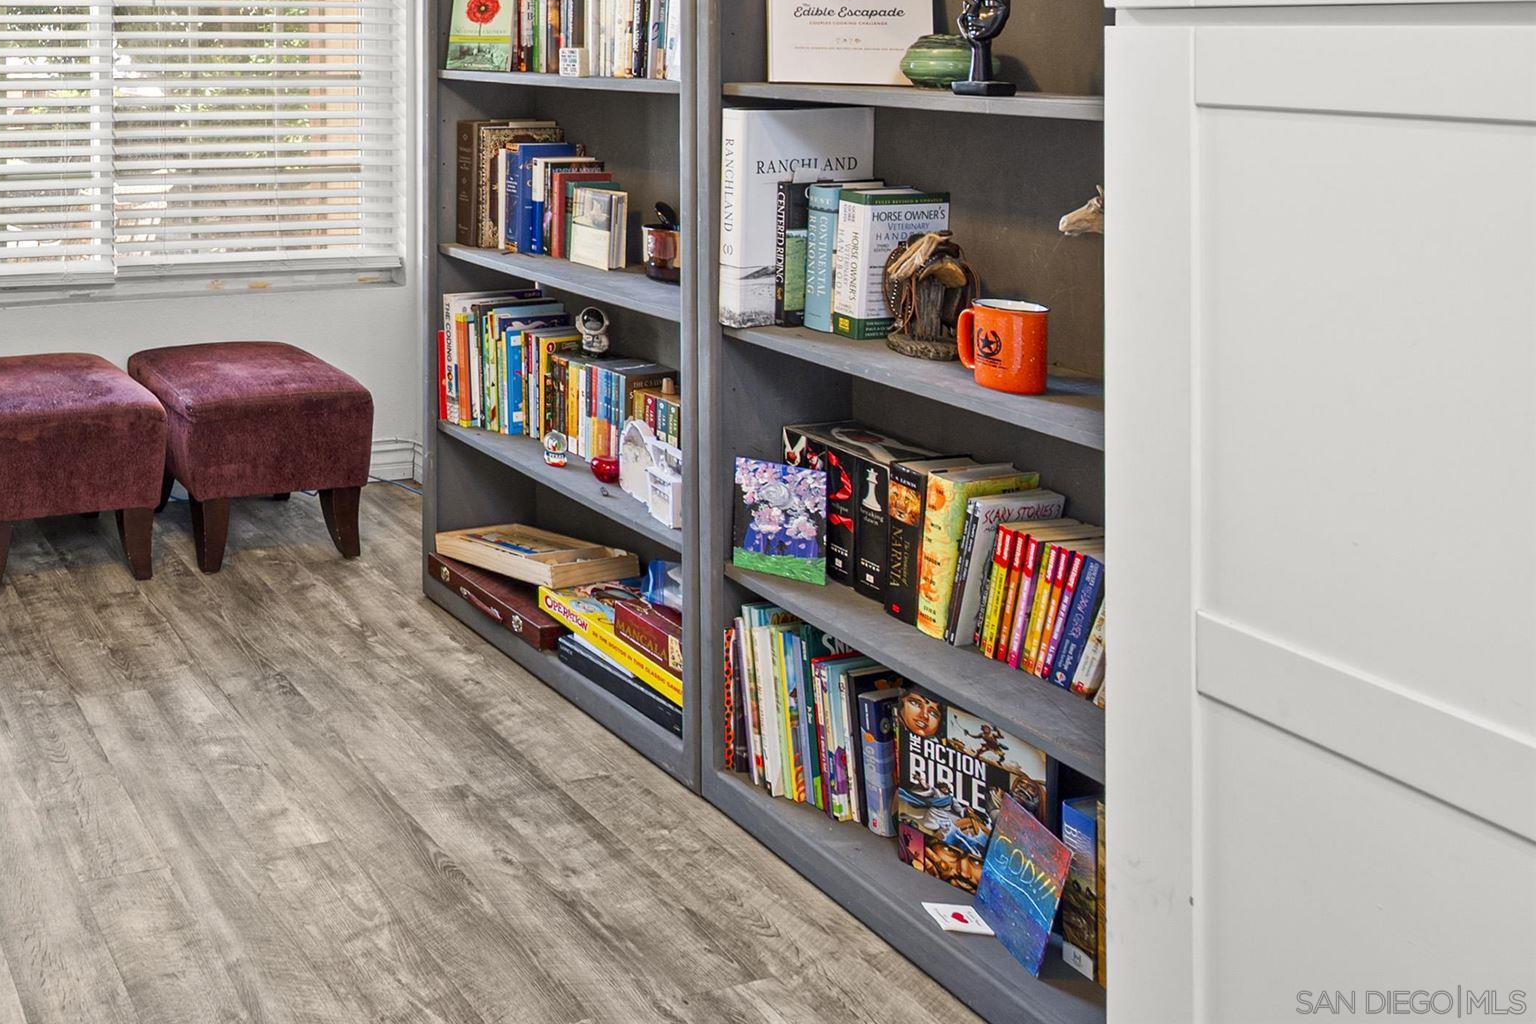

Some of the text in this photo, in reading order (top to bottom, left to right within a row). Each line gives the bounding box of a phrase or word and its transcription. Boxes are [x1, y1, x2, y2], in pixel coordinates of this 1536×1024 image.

[794, 7, 905, 21] Edible Escapade
[723, 138, 735, 232] RANCHLAND
[775, 191, 786, 283] CENTERED RIDING
[872, 207, 946, 222] HORSE OWNER'S
[888, 222, 930, 232] VETERINARY
[806, 215, 817, 295] RECKONING
[816, 215, 829, 297] CONTINENTAL
[850, 262, 858, 300] OWNER'S
[983, 508, 1012, 525] SCARY
[1016, 503, 1054, 520] STORIES
[889, 526, 904, 587] NARNIA
[615, 619, 667, 658] MANCALA
[910, 733, 986, 781] THE ACTION
[910, 753, 987, 814] BIBLE
